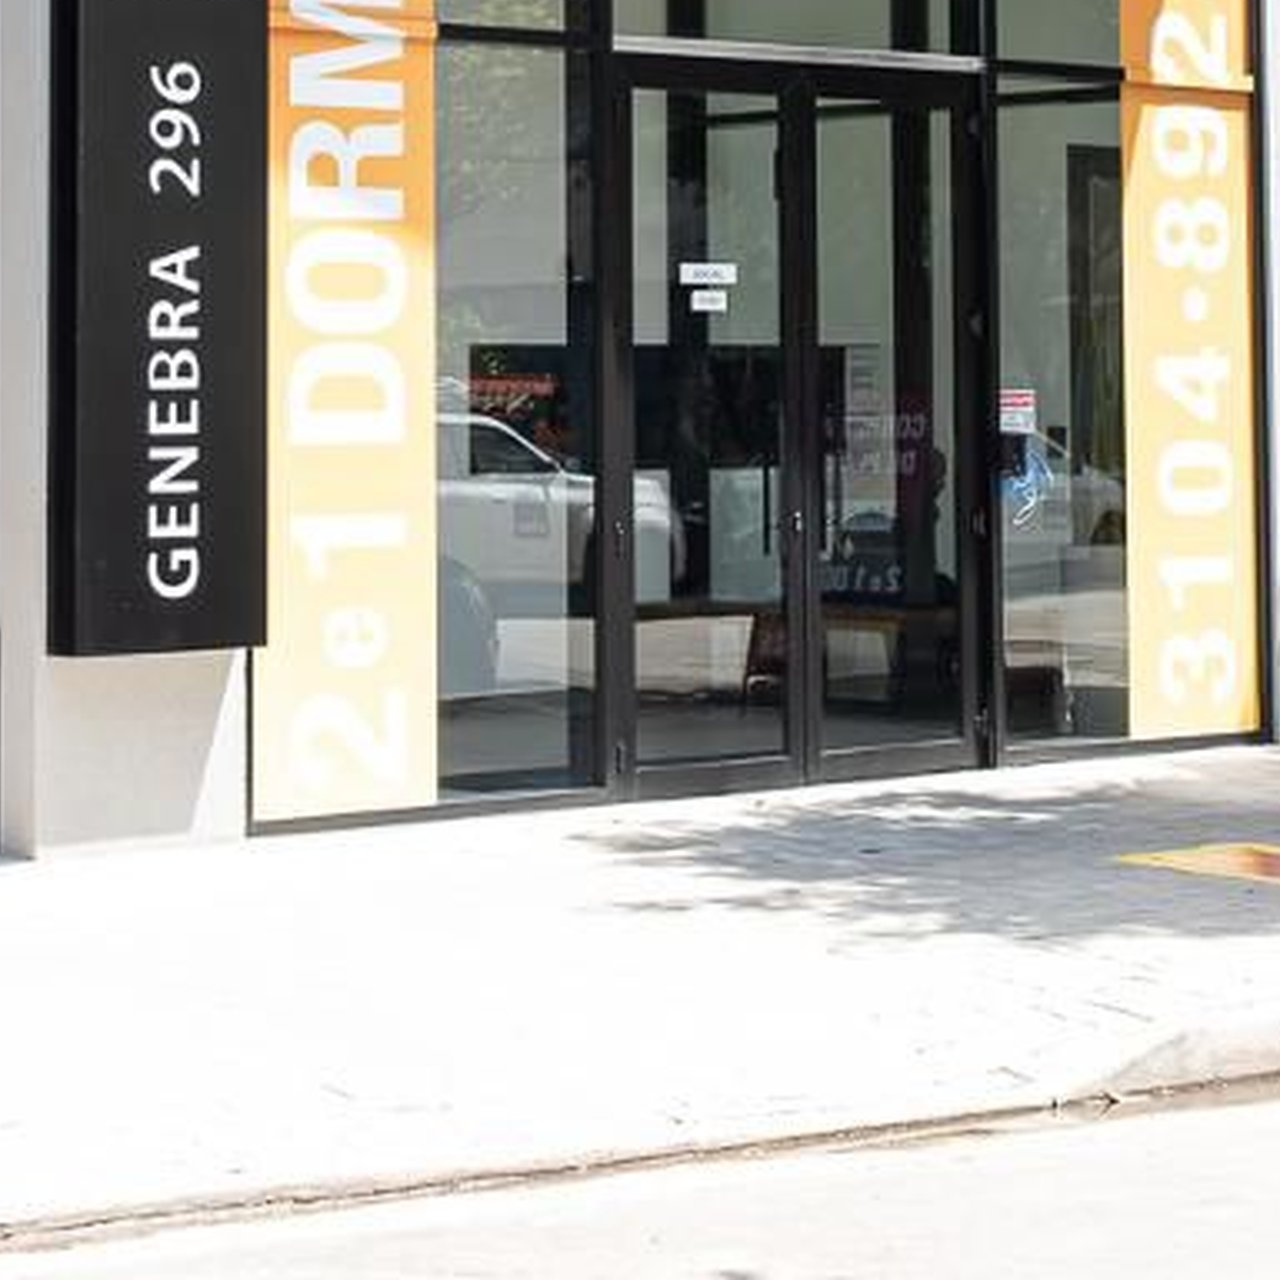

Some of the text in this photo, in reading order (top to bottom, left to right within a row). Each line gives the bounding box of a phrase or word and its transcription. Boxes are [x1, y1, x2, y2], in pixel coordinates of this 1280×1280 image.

[147, 60, 202, 600] GENEBRA 296
[290, 513, 408, 577] 1
